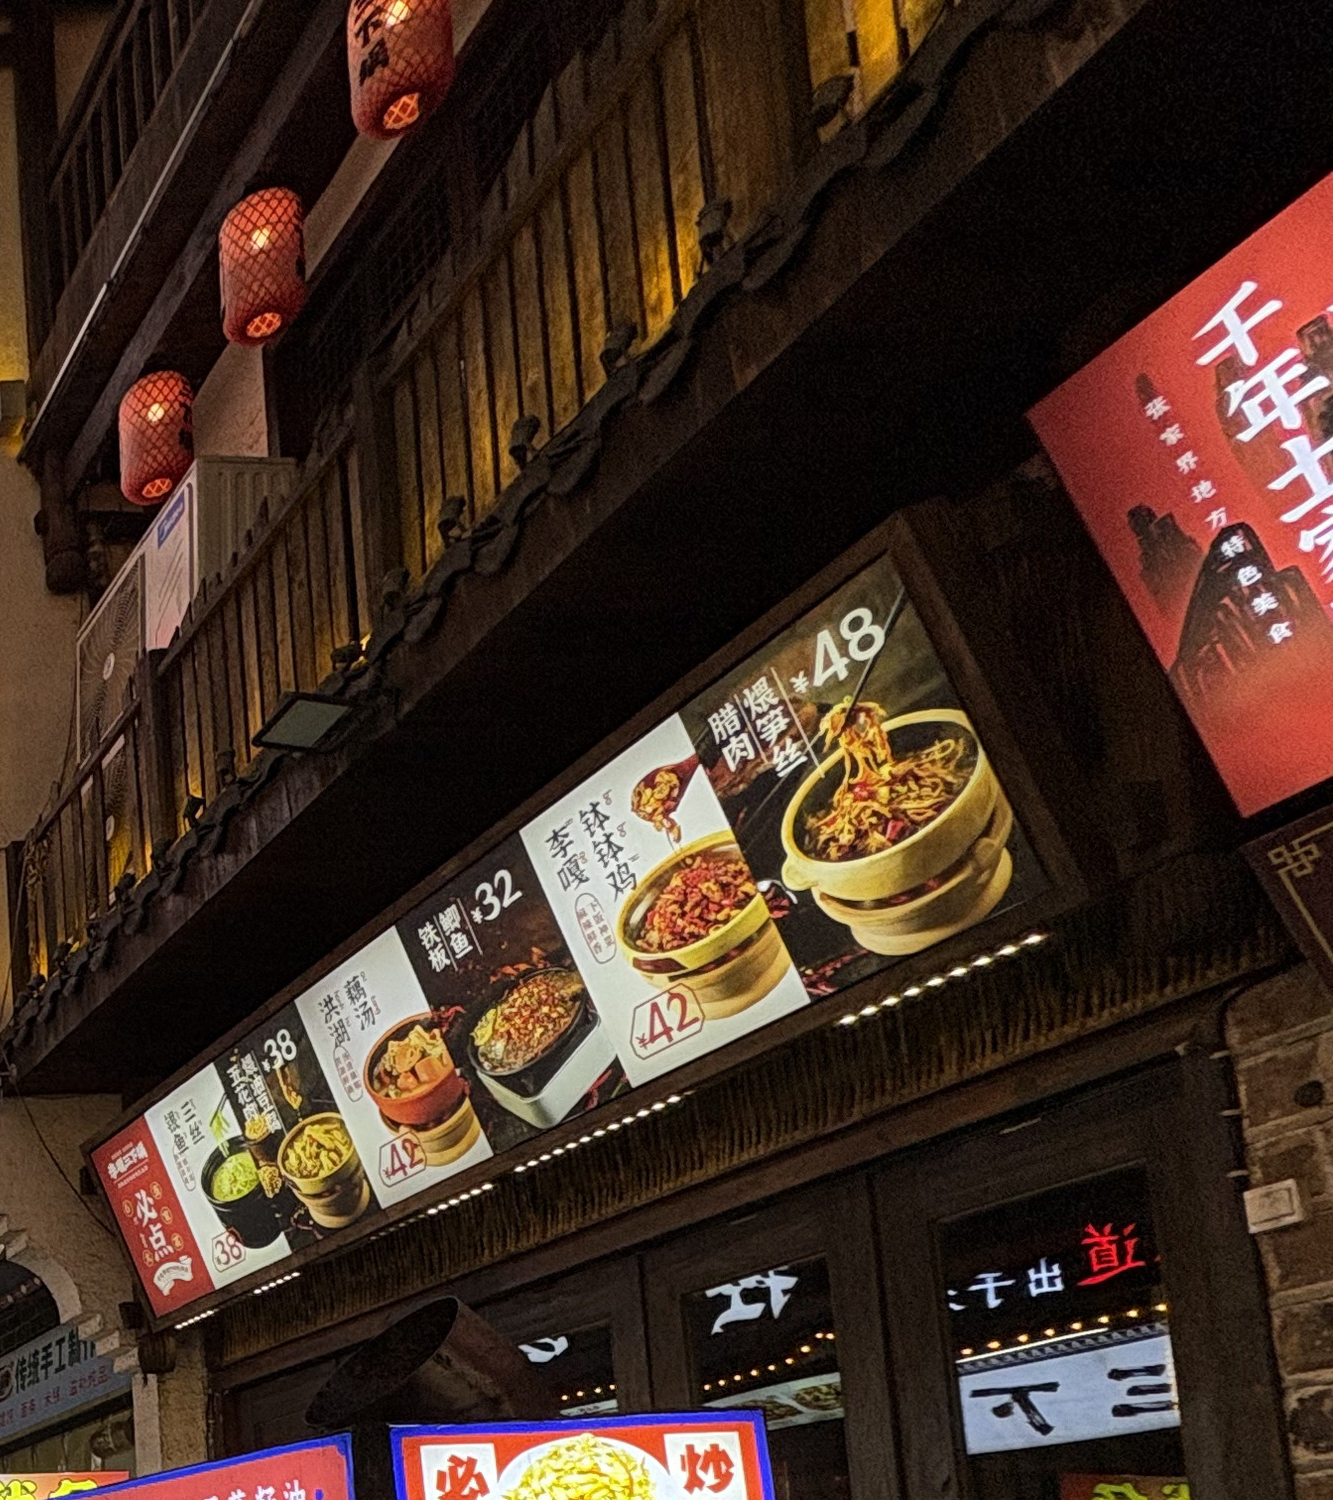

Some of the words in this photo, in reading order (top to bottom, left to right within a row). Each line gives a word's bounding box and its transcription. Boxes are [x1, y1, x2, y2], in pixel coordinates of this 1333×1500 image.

[1144, 395, 1294, 645] 张家界地方特色美食
[135, 1189, 174, 1262] 必点
